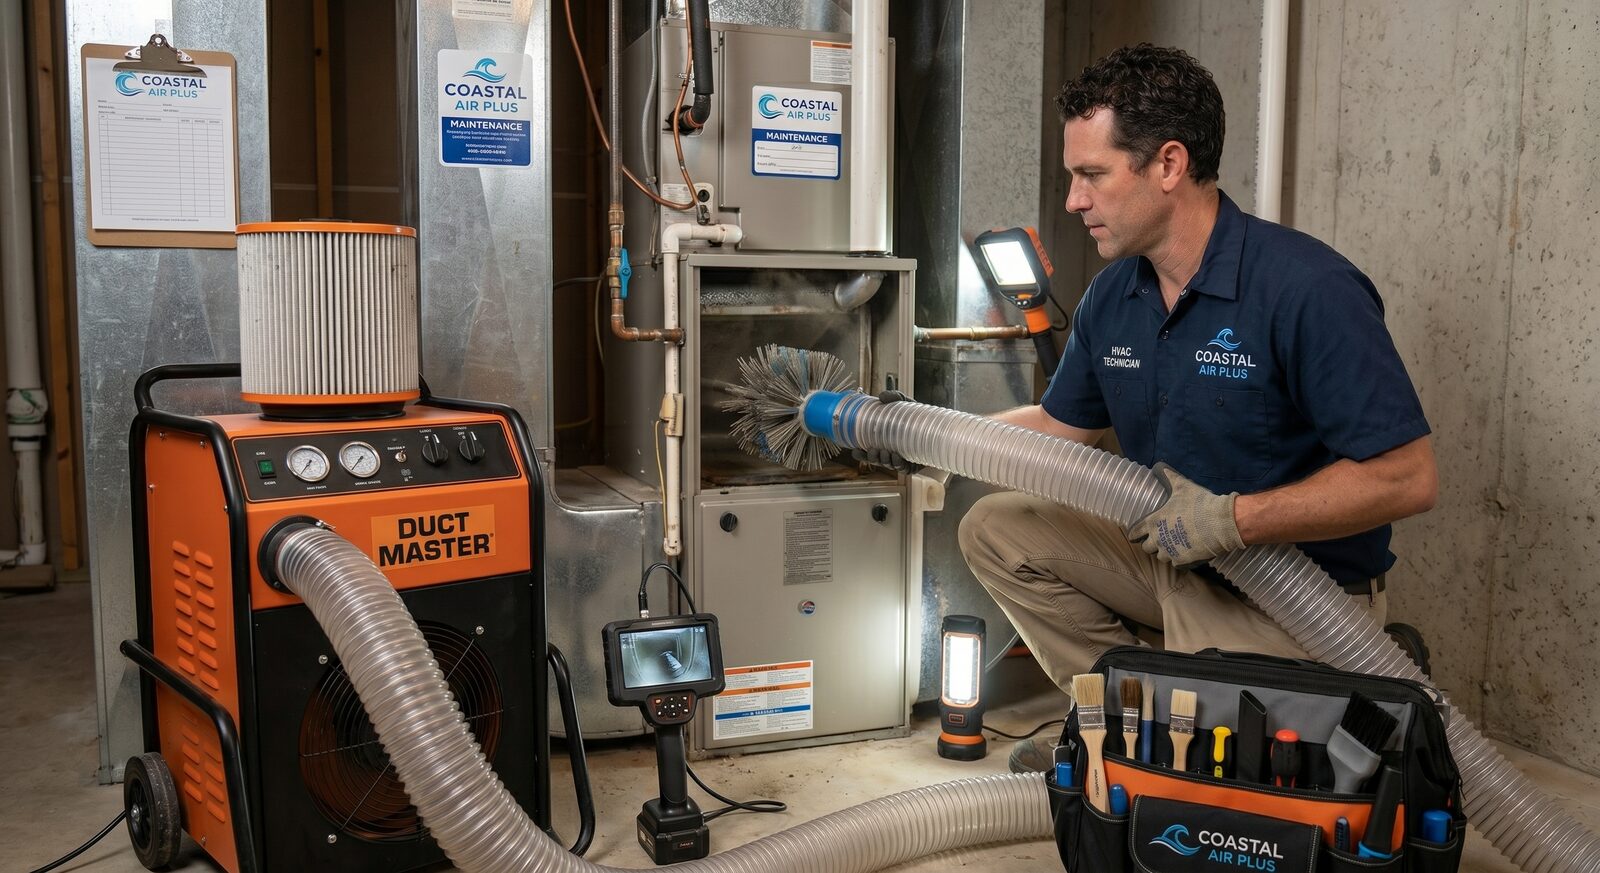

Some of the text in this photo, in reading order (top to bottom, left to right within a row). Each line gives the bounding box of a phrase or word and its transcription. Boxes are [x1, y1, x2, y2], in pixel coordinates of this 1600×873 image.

[142, 75, 207, 89] COASTAL
[148, 88, 198, 98] AIR PLUS
[445, 83, 527, 99] COASTAL
[455, 100, 518, 113] AIR PLUS
[781, 98, 838, 111] COASTAL
[787, 110, 831, 121] AIR PLUS
[450, 120, 523, 131] MAINTENANCE
[766, 132, 828, 143] MAINTENANCE
[1111, 346, 1132, 357] HVAC
[1103, 357, 1141, 369] TECHNICIAN
[1195, 350, 1257, 367] COASTAL
[1199, 364, 1248, 379] AIR PLUS
[397, 511, 470, 540] DUCT
[1198, 830, 1284, 860] COASTAL
[1207, 849, 1276, 873] AIR PLUS
